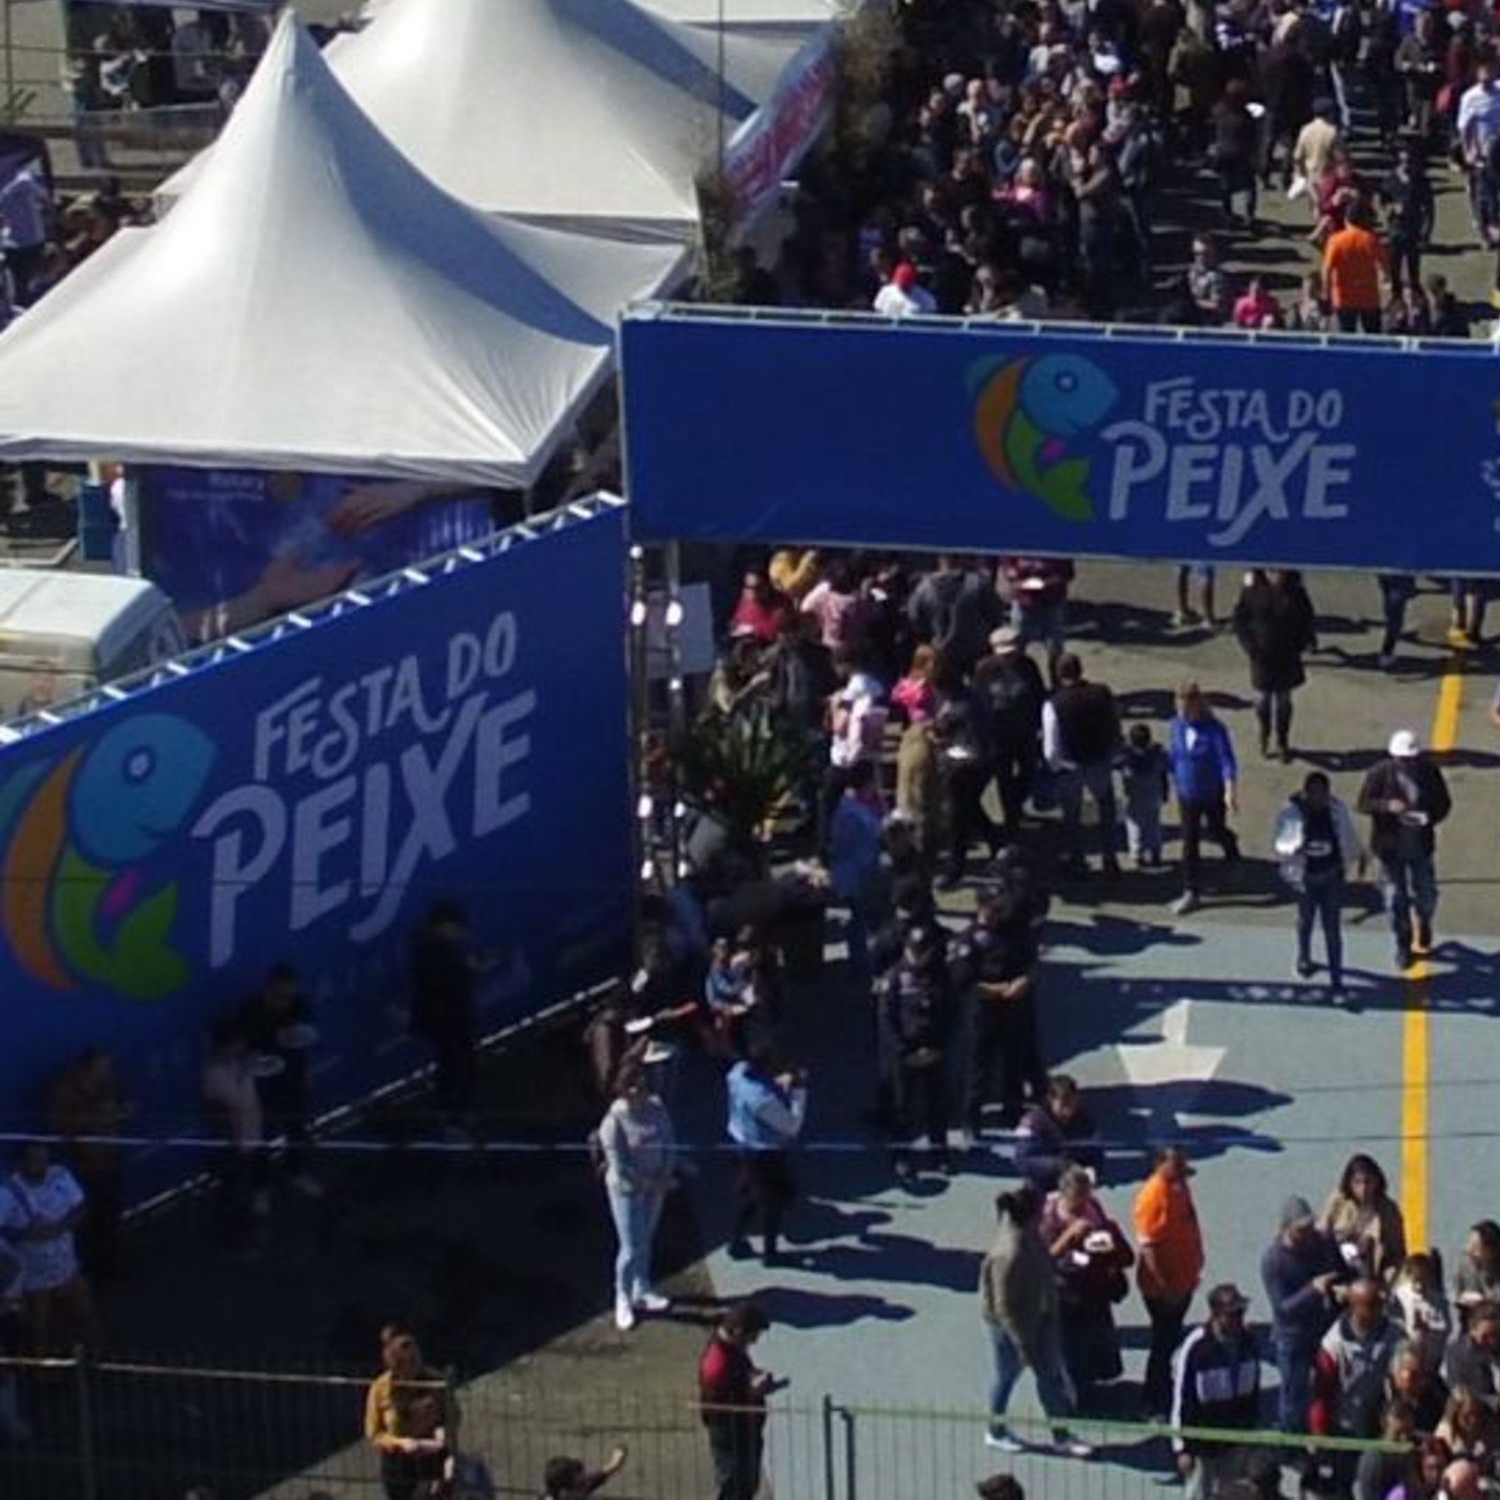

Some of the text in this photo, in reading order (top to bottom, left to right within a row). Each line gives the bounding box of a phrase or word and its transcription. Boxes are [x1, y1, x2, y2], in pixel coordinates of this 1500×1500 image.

[1101, 421, 1357, 546] PEIXE
[1144, 377, 1344, 443] FESTA DO
[254, 611, 518, 780] FESTA DO
[190, 690, 537, 969] PEIXE
